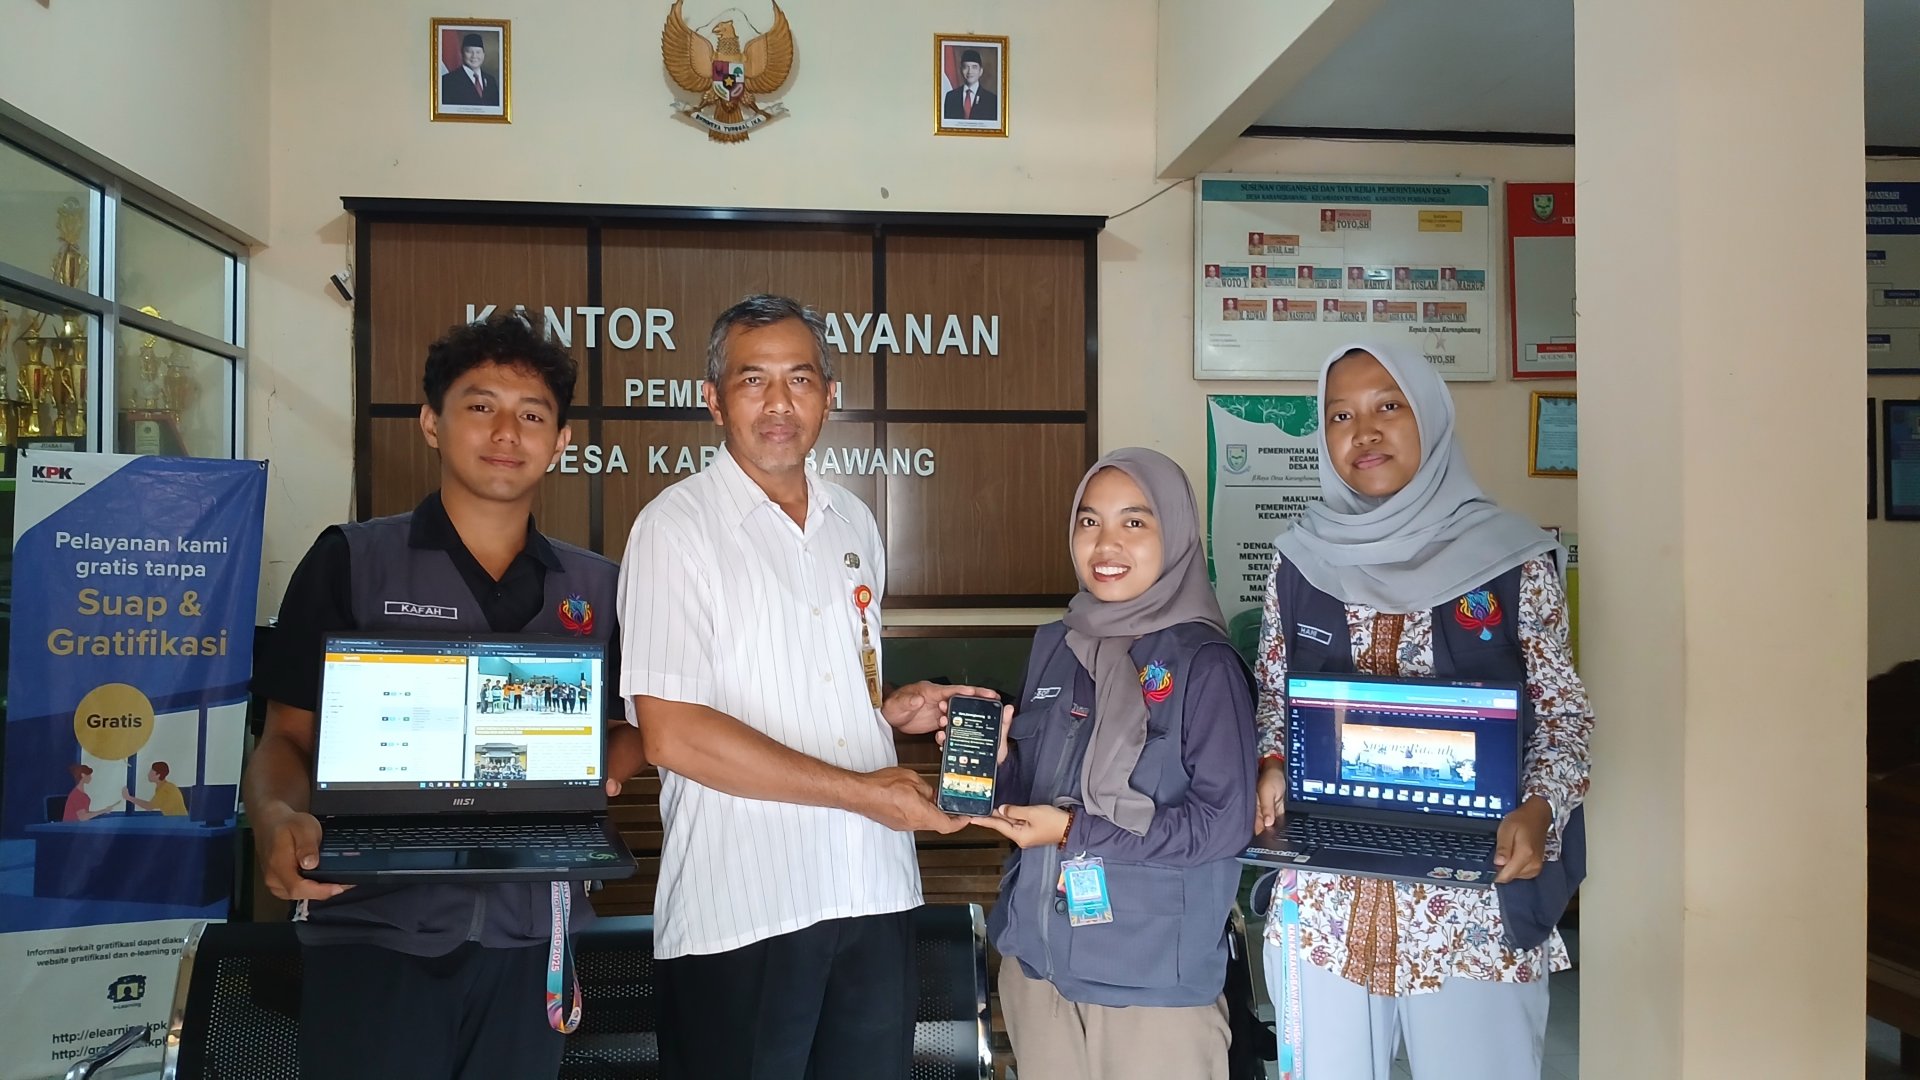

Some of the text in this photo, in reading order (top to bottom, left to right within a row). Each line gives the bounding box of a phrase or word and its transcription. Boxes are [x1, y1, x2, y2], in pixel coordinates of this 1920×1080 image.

[1276, 184, 1318, 193] ORGANISASI
[1321, 185, 1336, 193] DAN
[1337, 220, 1369, 230] TOYO,SH
[546, 445, 629, 474] ESA
[1258, 447, 1305, 455] PEMERINTAH
[32, 465, 73, 480] KPK
[56, 532, 228, 554] Pelayanan kami
[76, 559, 206, 580] gratis tanpa
[78, 588, 202, 622] Suap &
[401, 604, 442, 616] KAFAH
[47, 628, 228, 656] Gratifikasi
[86, 713, 143, 729] Gratis
[452, 798, 475, 806] MSI
[554, 907, 562, 946] UNSOED
[27, 947, 67, 957] Informasi
[68, 943, 94, 953] terkait
[96, 940, 136, 950] gratifikasi
[137, 938, 160, 948] dapat
[37, 957, 69, 967] website
[71, 952, 111, 964] gratifikasi
[113, 951, 128, 959] dan
[130, 947, 170, 958] e-learning
[551, 948, 561, 972] 2025
[1288, 942, 1300, 1018] KARANGBAWANG
